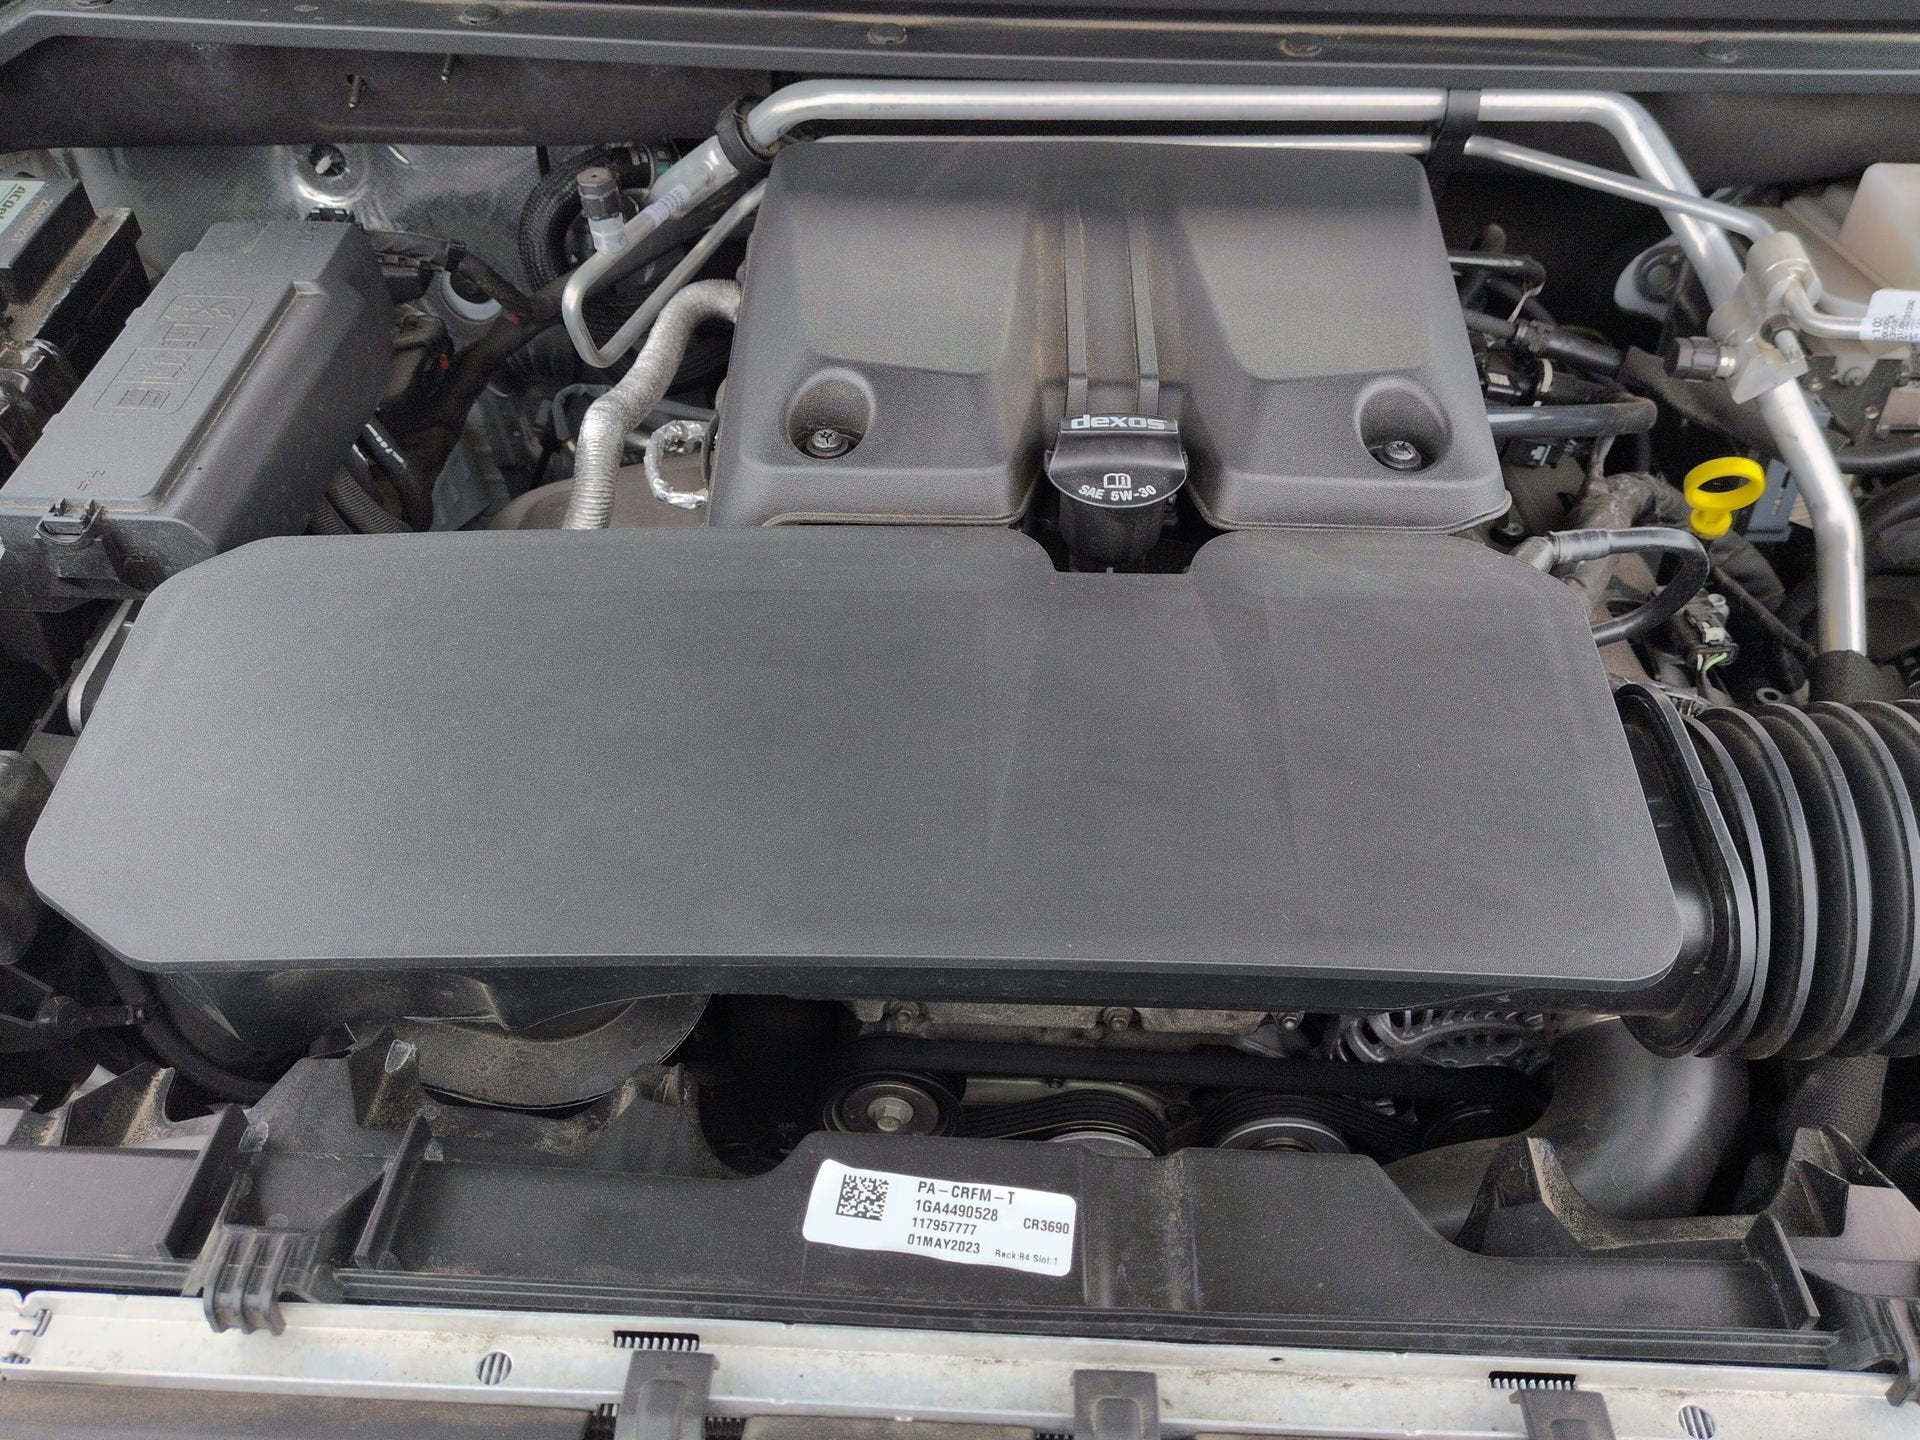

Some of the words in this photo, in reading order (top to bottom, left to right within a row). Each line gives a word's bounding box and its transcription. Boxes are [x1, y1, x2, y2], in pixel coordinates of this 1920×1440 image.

[1070, 414, 1166, 430] dexos
[1078, 485, 1105, 500] SAE
[1110, 485, 1157, 501] 5W-30
[915, 1199, 998, 1222] 1GA4490528
[912, 1217, 977, 1235] 117957777
[1023, 1217, 1070, 1234] CR3690
[907, 1233, 981, 1254] 01MAY2023
